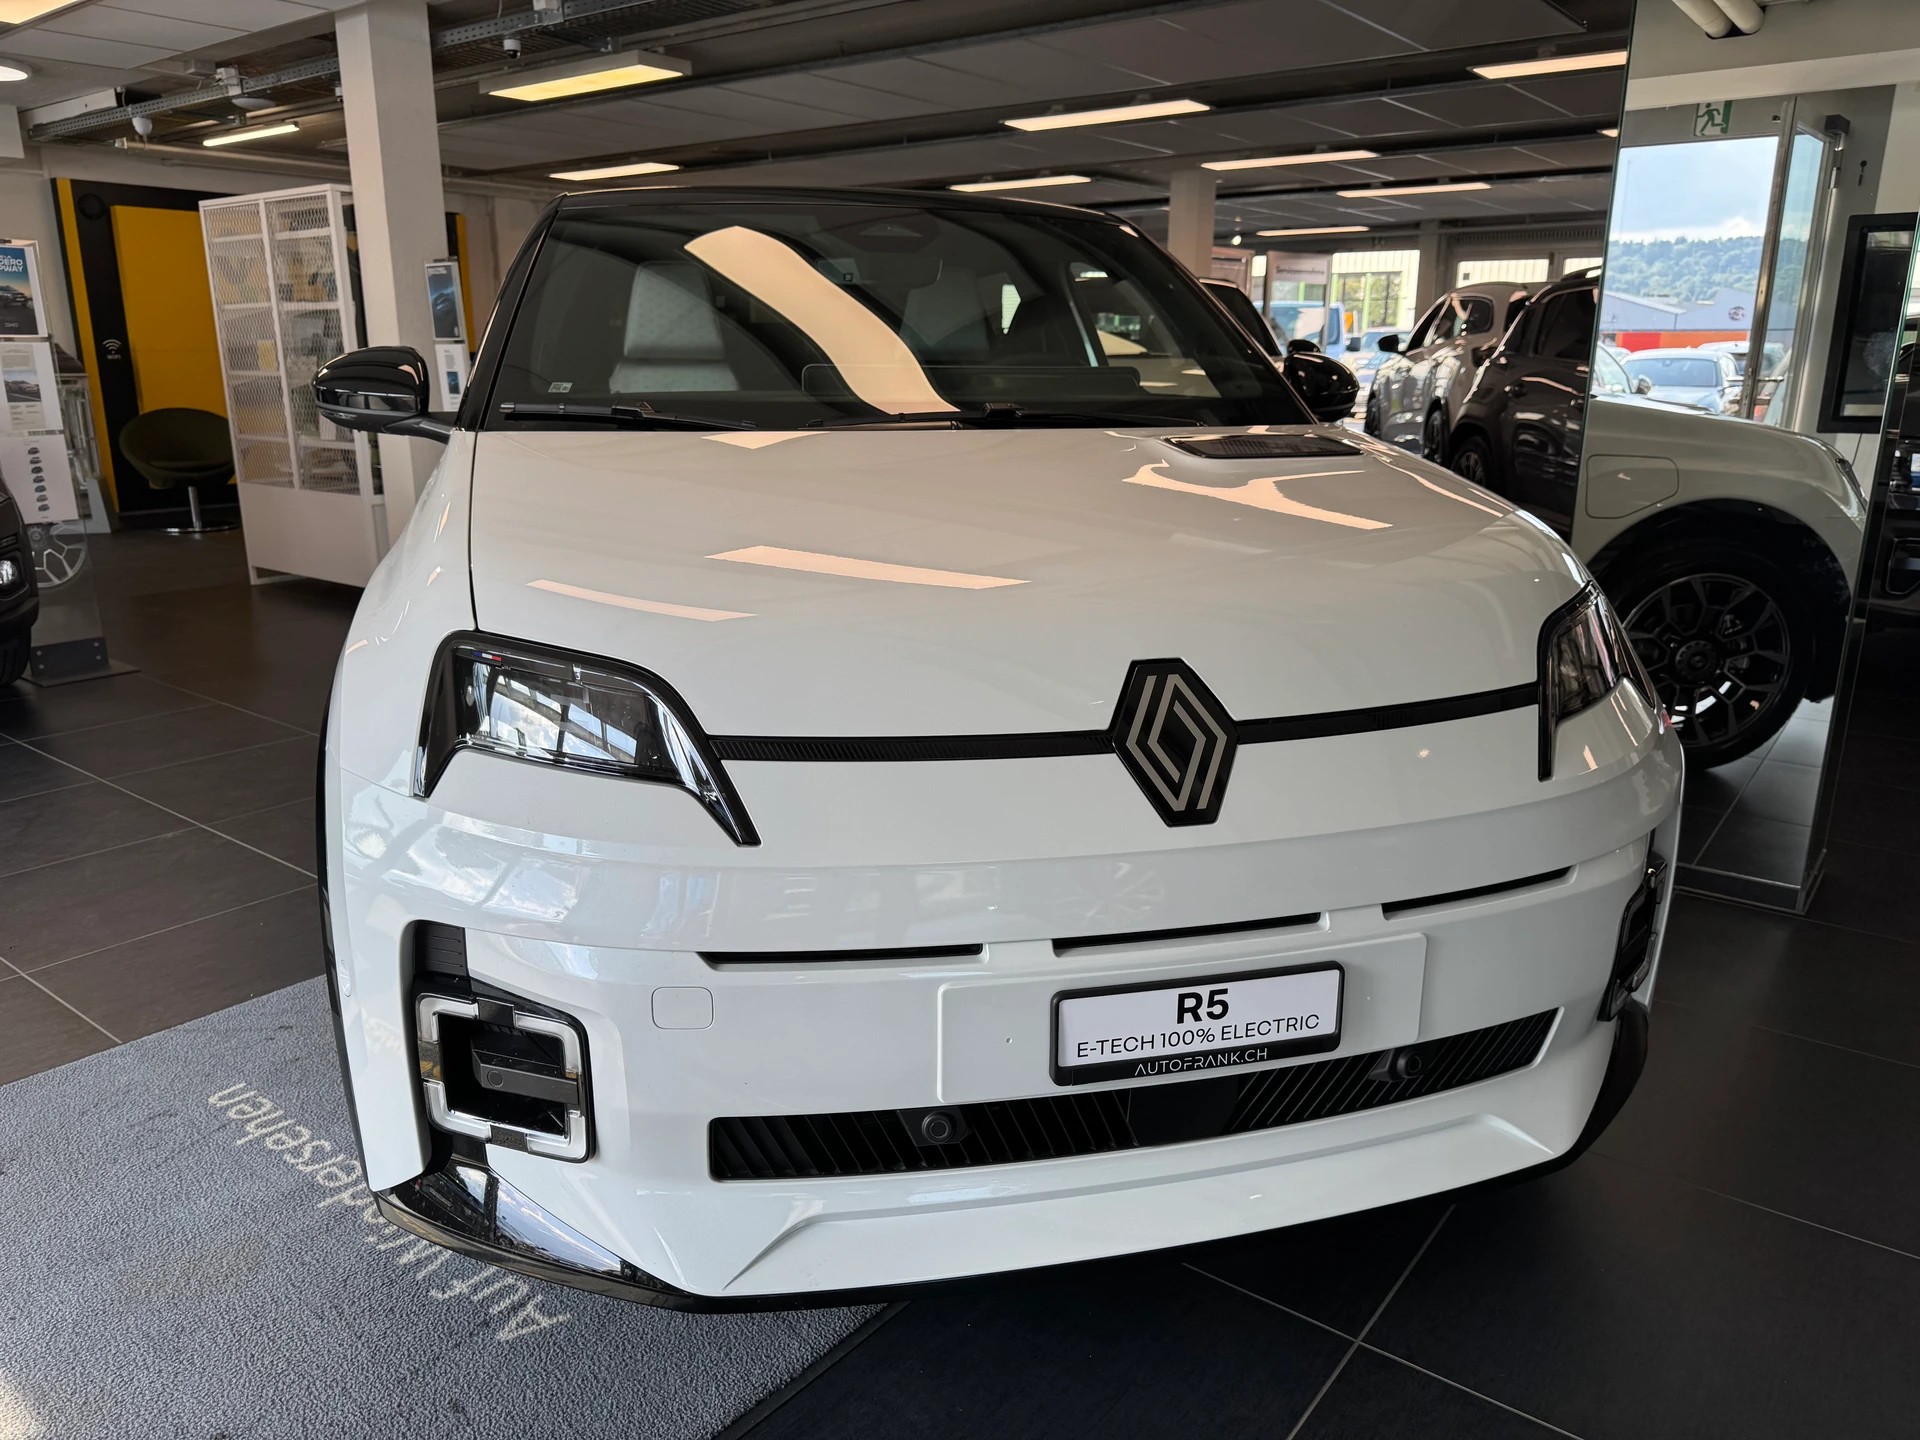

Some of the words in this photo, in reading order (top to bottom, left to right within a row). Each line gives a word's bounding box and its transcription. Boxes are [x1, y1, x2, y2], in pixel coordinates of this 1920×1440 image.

[1176, 988, 1229, 1025] R5
[1077, 1033, 1155, 1058] E-TECH
[1160, 1027, 1215, 1049] 100%
[1221, 1013, 1320, 1042] ELECTRIC
[1134, 1047, 1268, 1077] AUTOFRANK.CH
[430, 1263, 573, 1341] Auf
